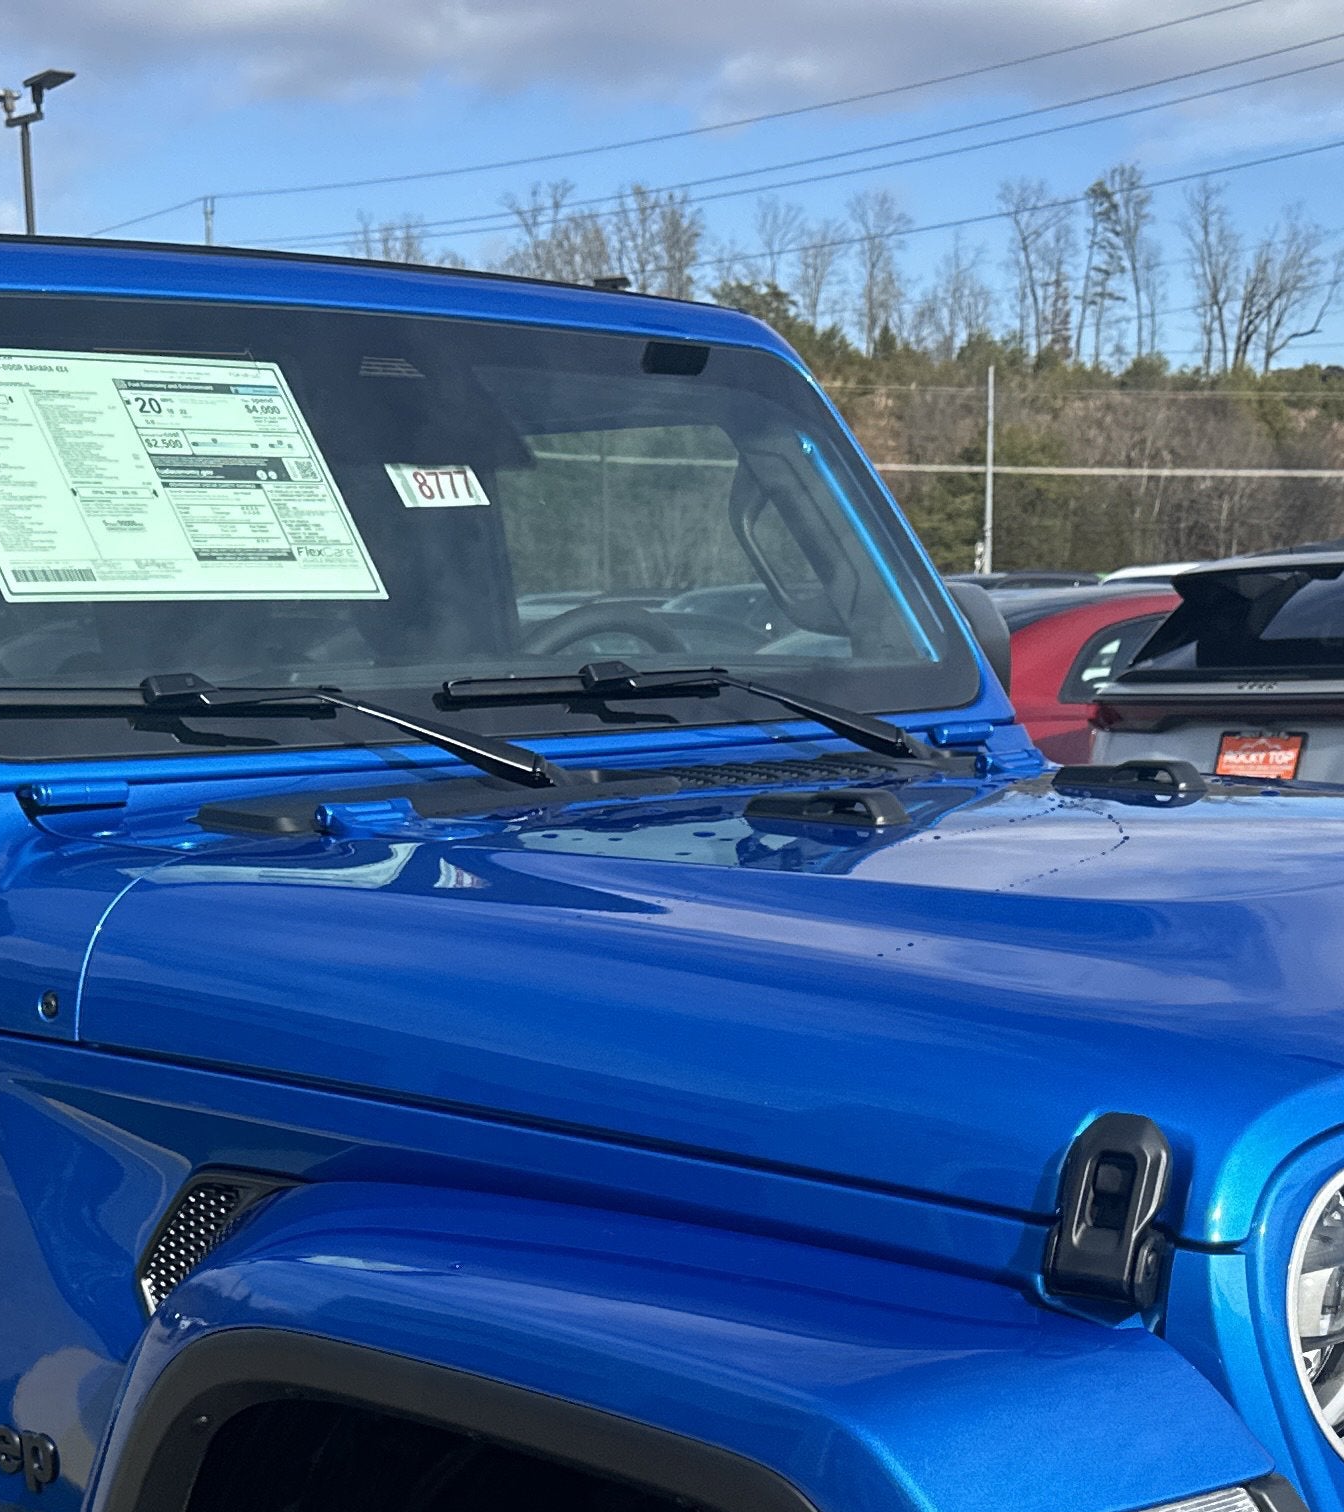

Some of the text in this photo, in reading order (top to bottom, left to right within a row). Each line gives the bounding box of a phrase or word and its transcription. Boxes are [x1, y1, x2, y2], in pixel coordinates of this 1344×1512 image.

[134, 397, 162, 414] 20
[244, 404, 281, 415] $4,000
[144, 438, 183, 449] $2,500
[412, 471, 474, 500] 8777
